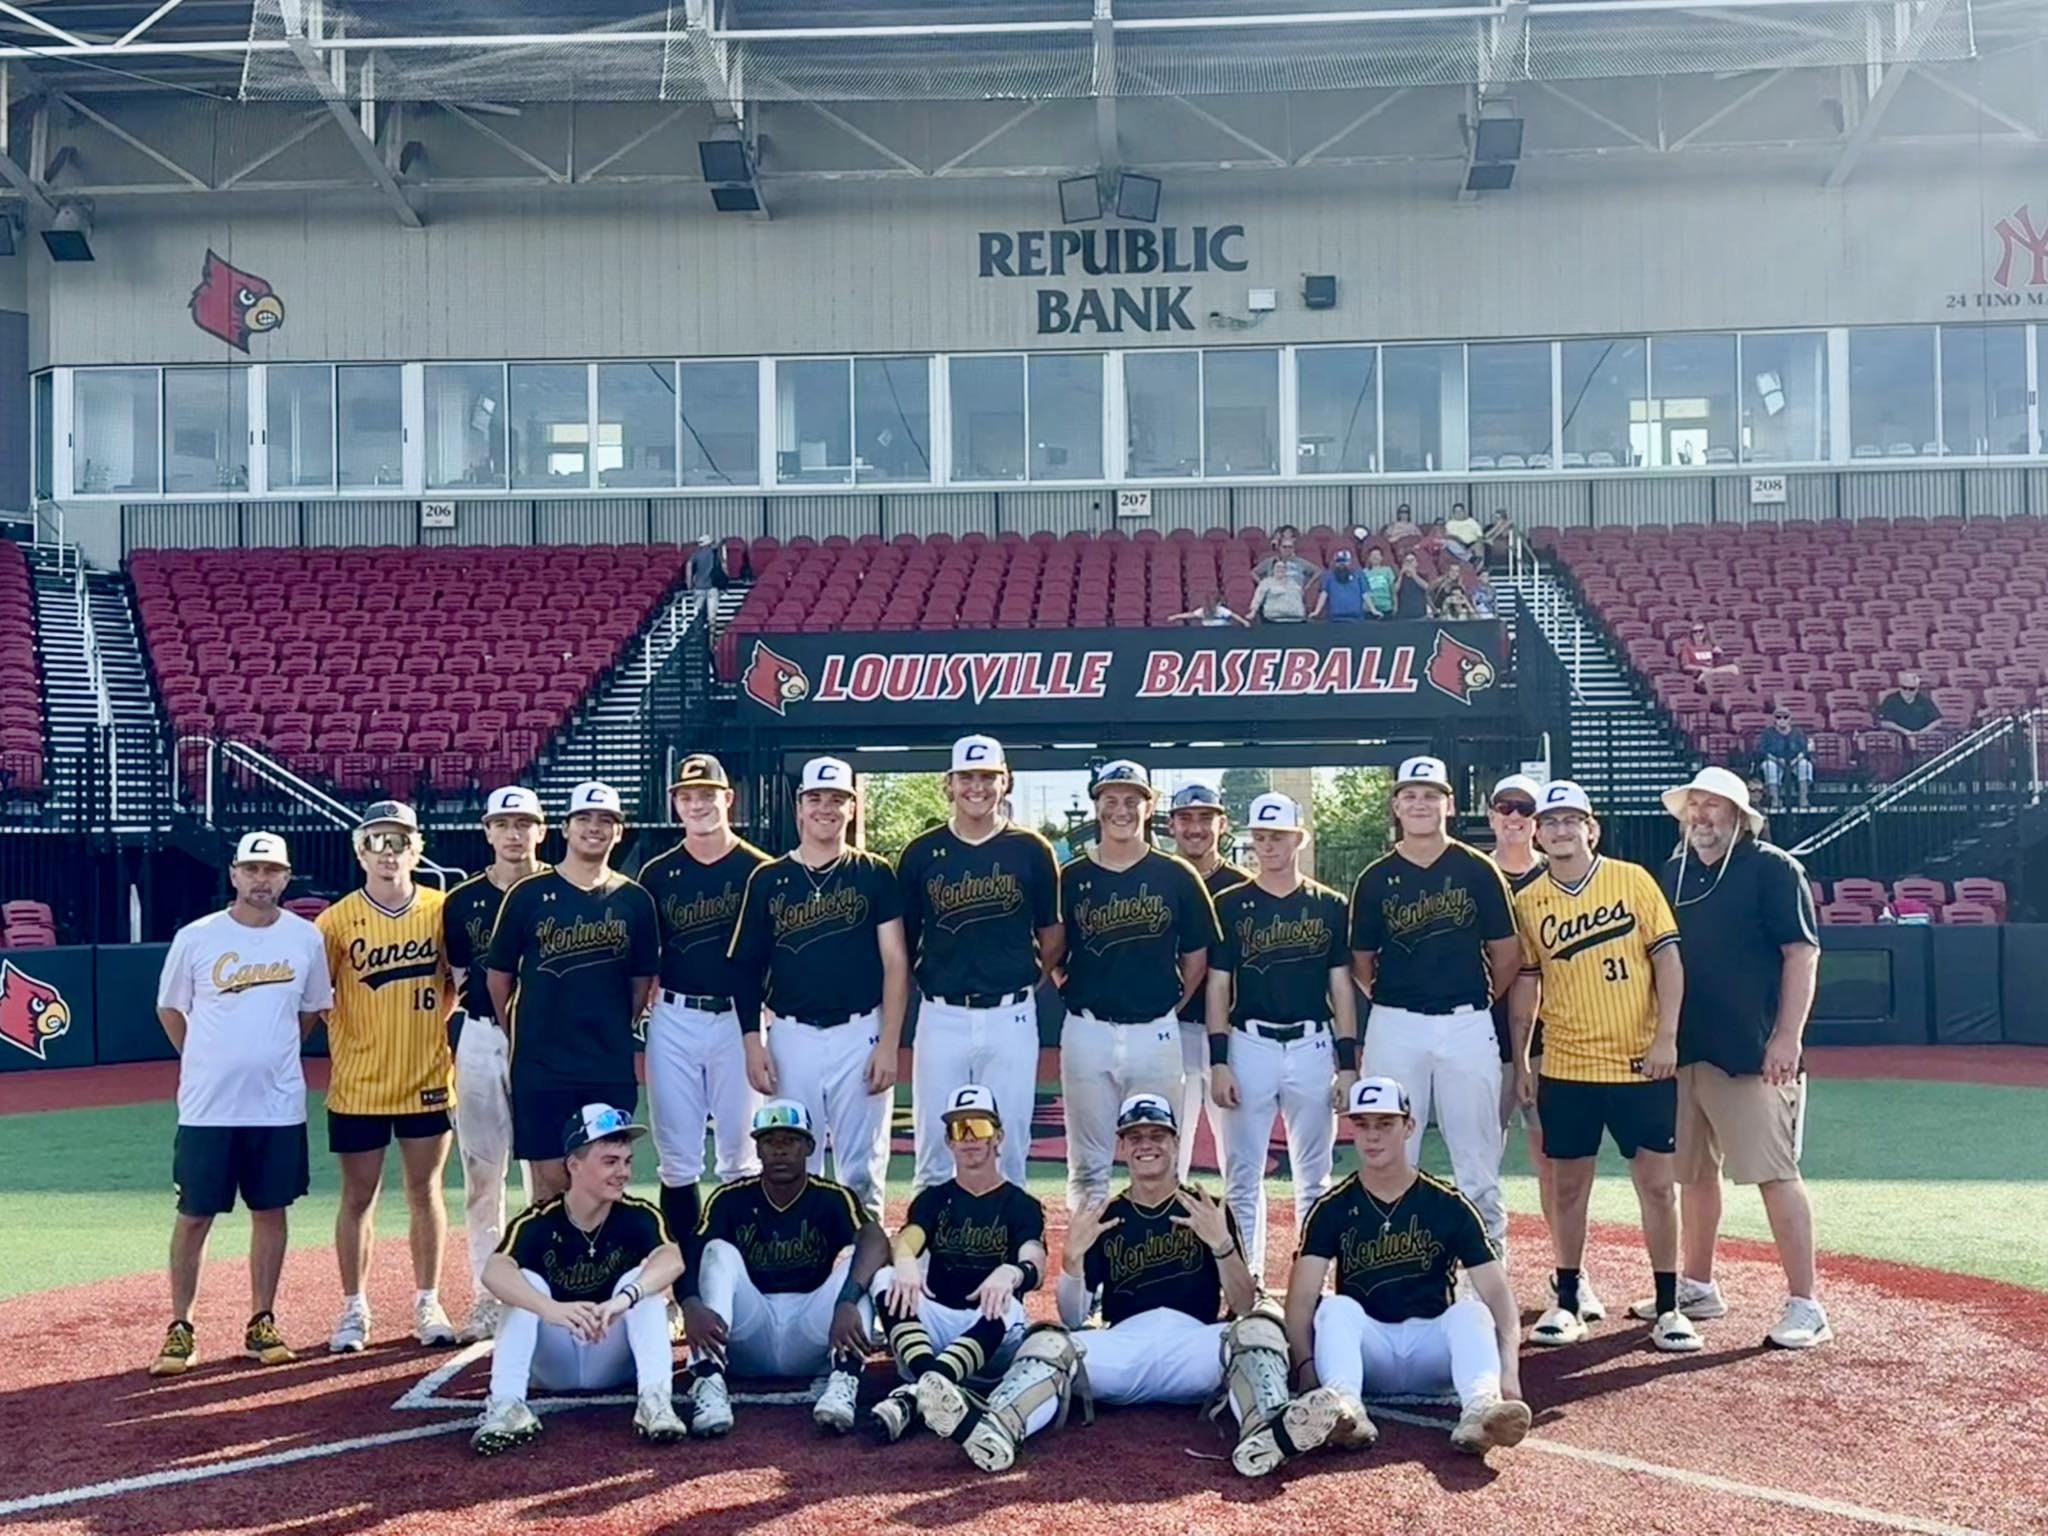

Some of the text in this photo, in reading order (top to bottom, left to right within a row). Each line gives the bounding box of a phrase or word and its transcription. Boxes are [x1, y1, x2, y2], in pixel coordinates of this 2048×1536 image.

[978, 225, 1249, 277] REPUBLIC
[1036, 286, 1196, 334] BANK
[1945, 294, 1966, 308] 24
[1974, 293, 2020, 307] TINO
[1120, 493, 1147, 506] 207
[1754, 479, 1782, 491] 208
[425, 504, 452, 517] 206
[812, 646, 1419, 705] LOUISVILLE BASEBALL
[681, 759, 707, 777] C
[769, 877, 868, 936] Kentucky
[926, 862, 1024, 914] Kentucky
[1073, 883, 1173, 939] Kentucky
[535, 906, 632, 958] Kentucky
[1235, 906, 1333, 957] Kentucky
[1540, 899, 1635, 950] Canes
[212, 952, 296, 988] Canes
[350, 937, 440, 972] Canes
[1602, 957, 1629, 981] 31
[413, 987, 436, 1011] 16
[1340, 1213, 1446, 1274] Kentucky
